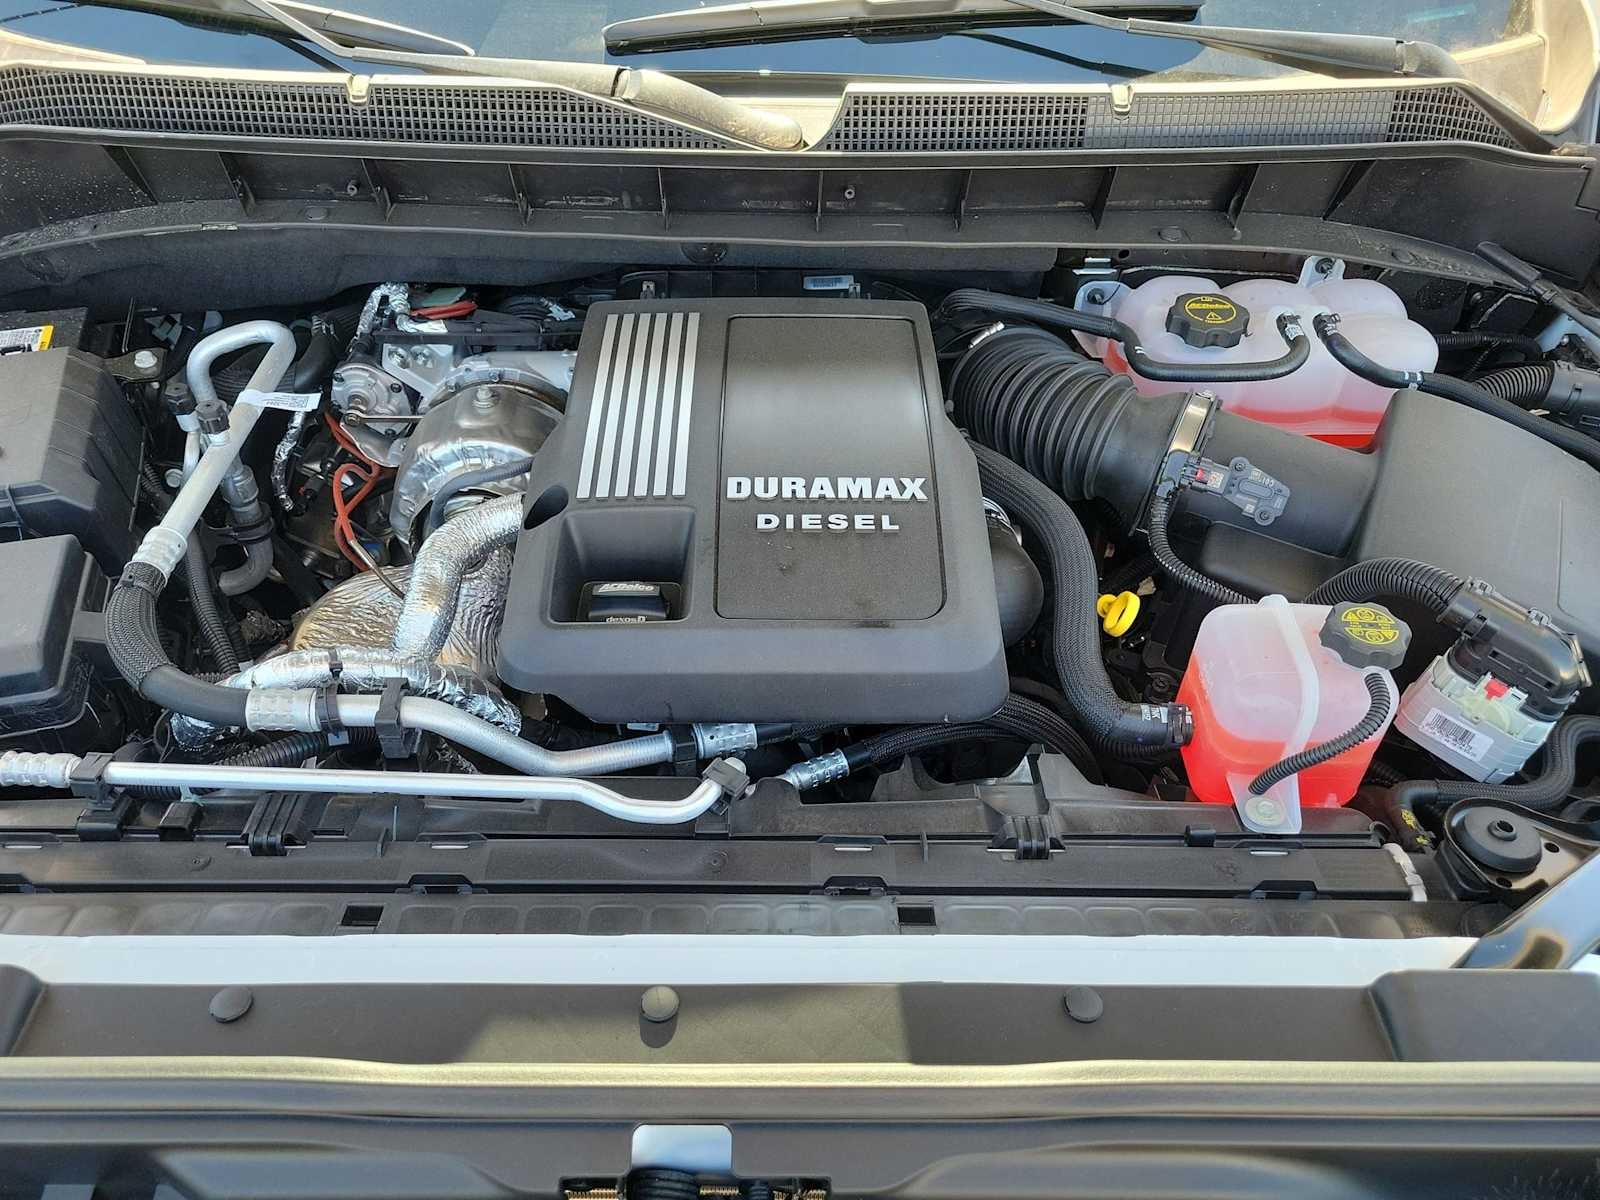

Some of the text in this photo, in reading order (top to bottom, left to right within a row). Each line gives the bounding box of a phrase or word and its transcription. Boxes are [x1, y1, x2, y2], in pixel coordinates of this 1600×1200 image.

[727, 476, 928, 501] DURAMAX
[756, 513, 900, 532] DIESEL
[598, 583, 655, 593] ACDelco
